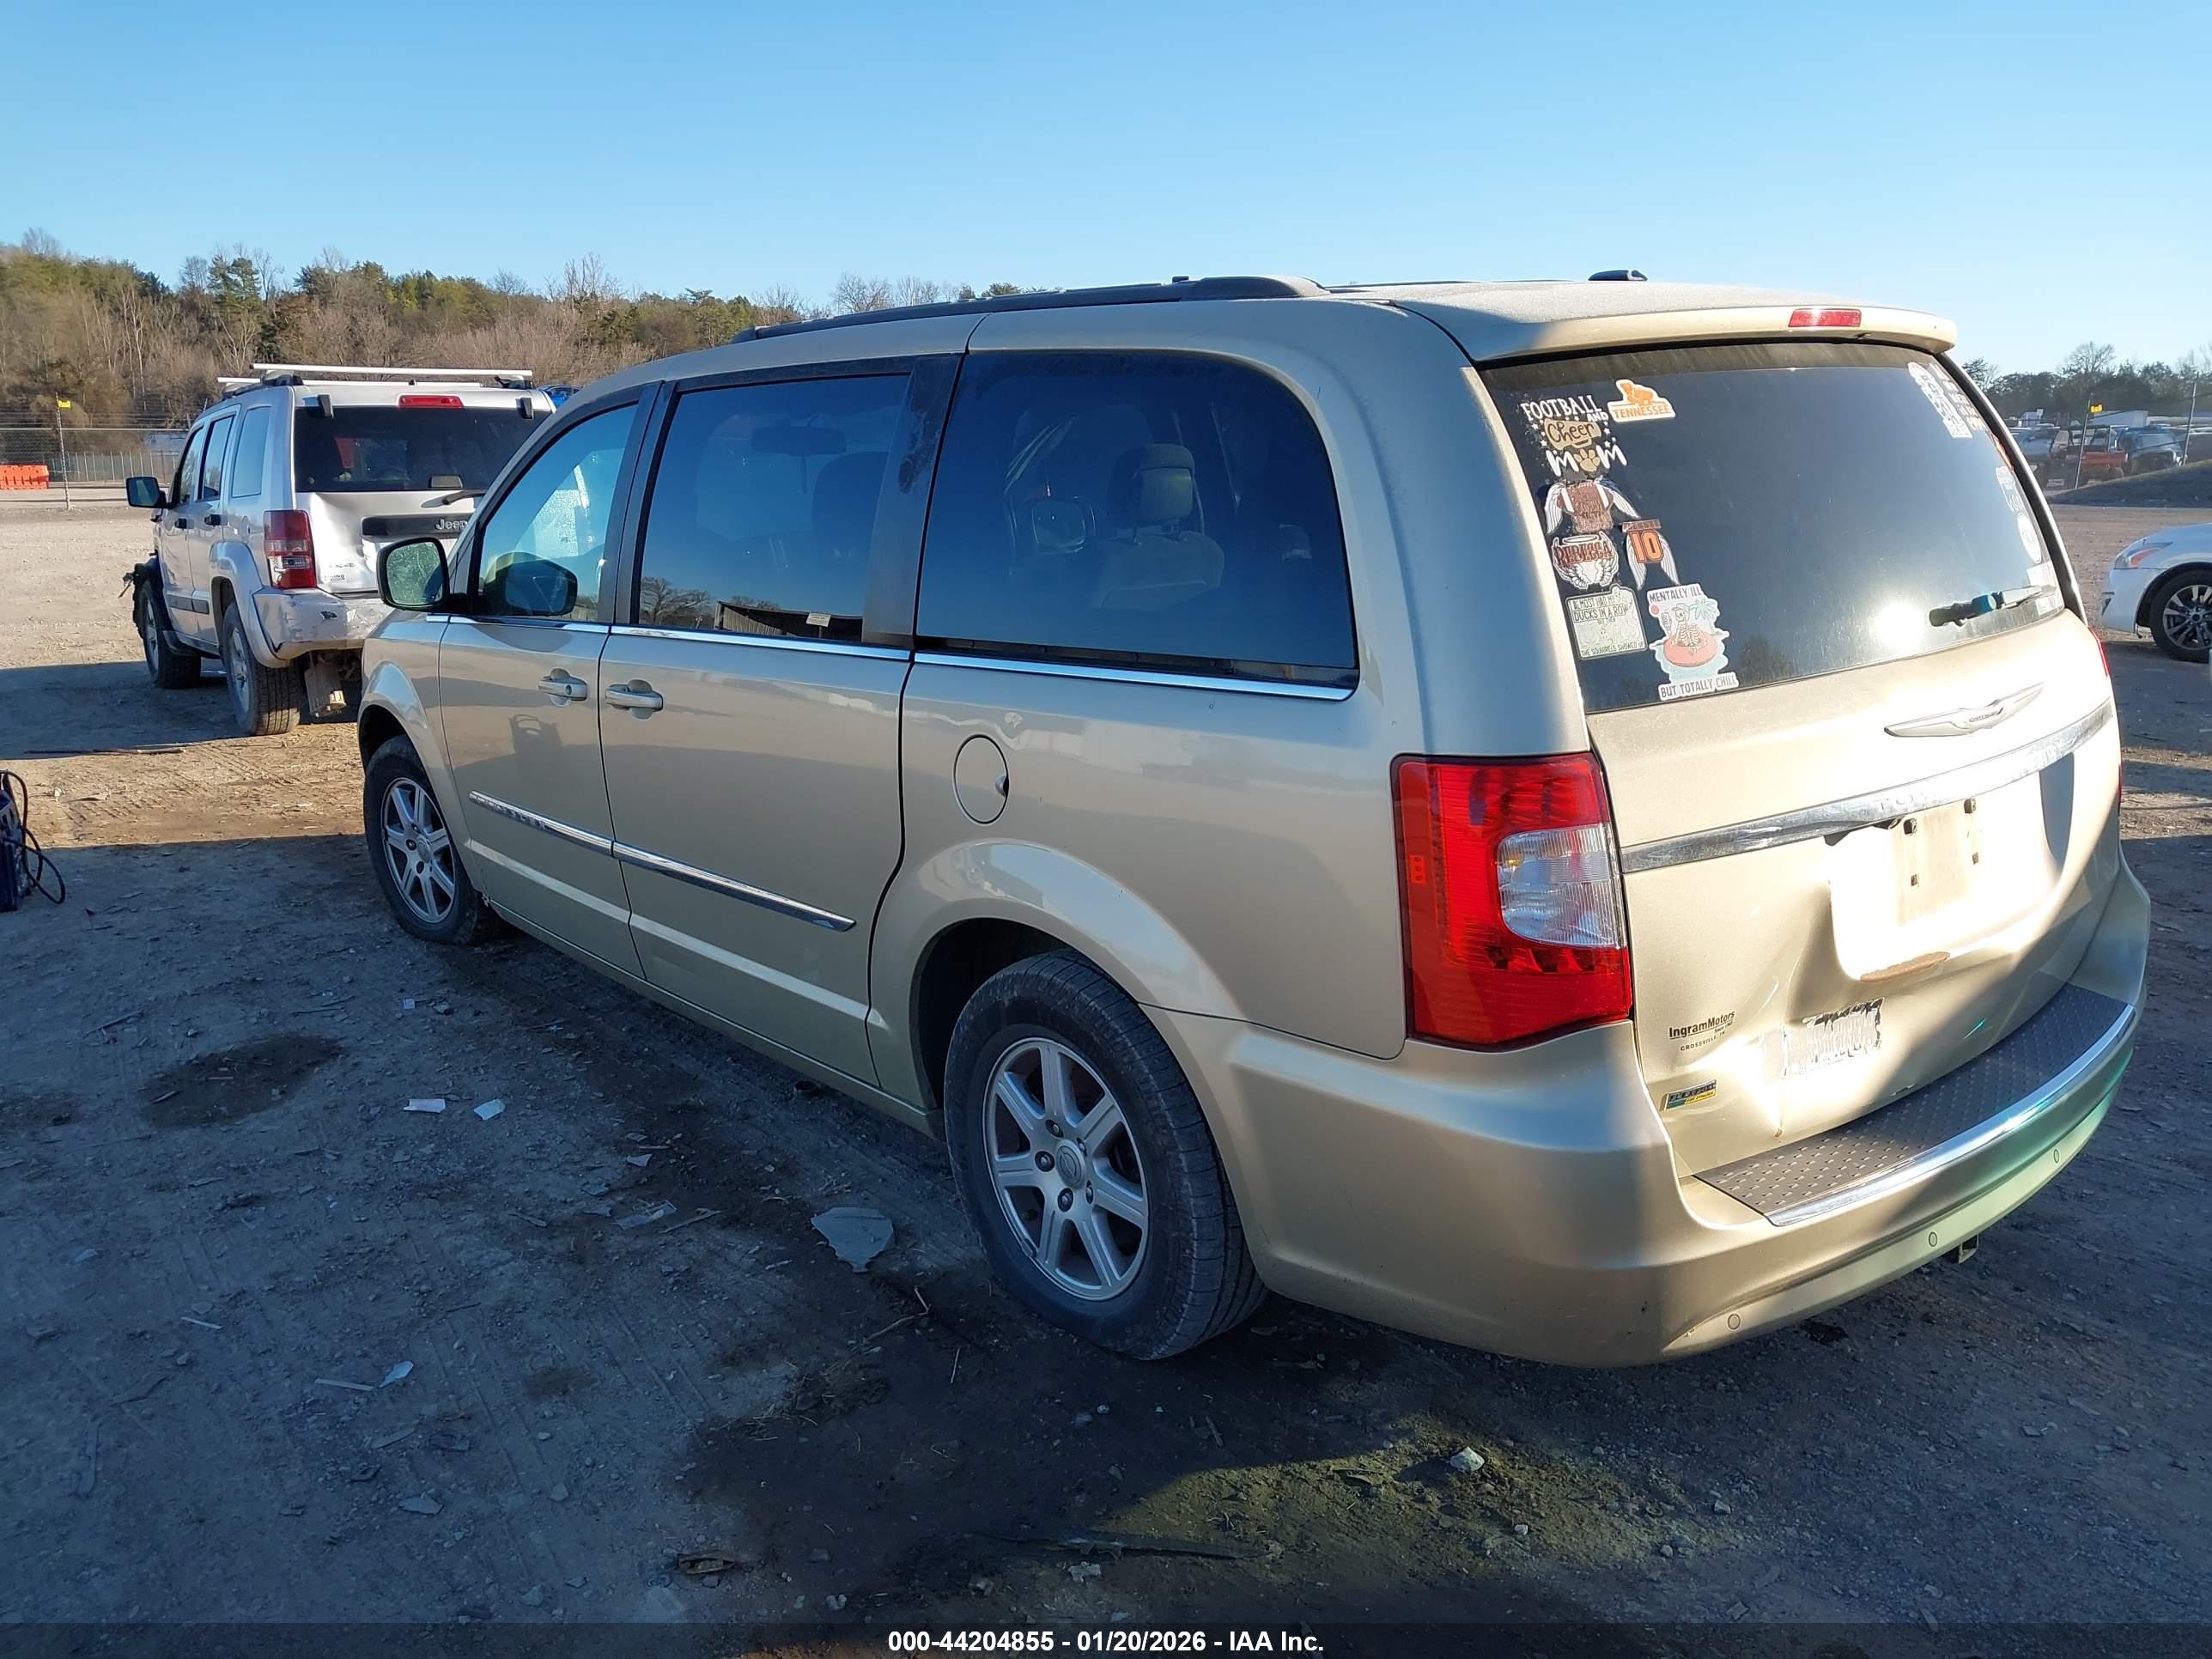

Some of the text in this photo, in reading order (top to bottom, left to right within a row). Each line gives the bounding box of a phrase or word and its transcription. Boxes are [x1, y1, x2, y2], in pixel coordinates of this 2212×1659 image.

[1521, 395, 1602, 421] FOOTBALL
[1587, 411, 1609, 422] AND
[1613, 404, 1671, 419] TENNESSEE
[1547, 422, 1595, 443] Cheer
[435, 519, 468, 530] Jeep
[1628, 529, 1664, 563] 10
[1650, 586, 1702, 603] MENTALLY ILL
[1573, 604, 1629, 622] DUCKS IN A ROW
[1660, 674, 1736, 698] BUT TOTALLY CHILL
